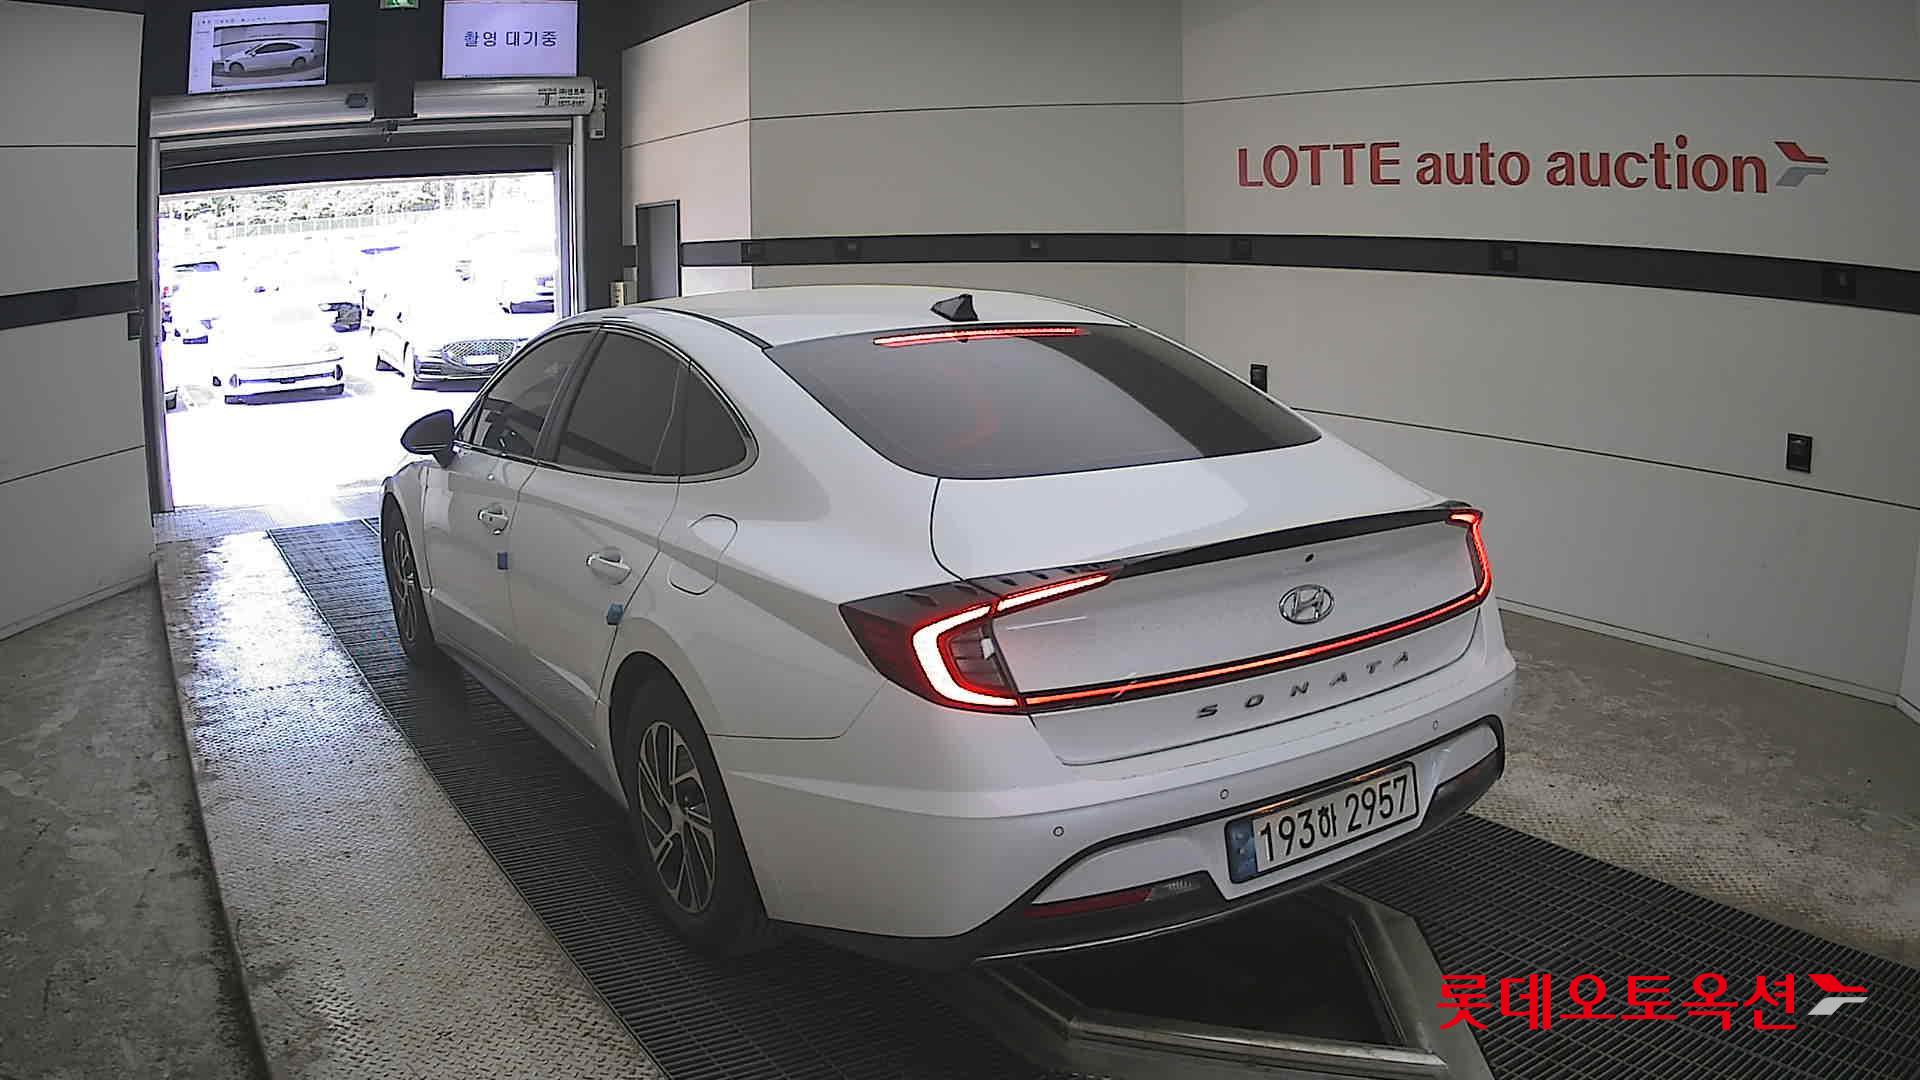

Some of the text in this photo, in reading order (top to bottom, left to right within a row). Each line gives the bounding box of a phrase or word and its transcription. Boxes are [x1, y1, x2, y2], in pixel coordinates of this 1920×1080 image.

[505, 31, 557, 47] 대기중
[1237, 134, 1767, 193] LOTTE auto auction
[1196, 651, 1409, 719] SONATA
[1260, 775, 1407, 862] 193하 2957
